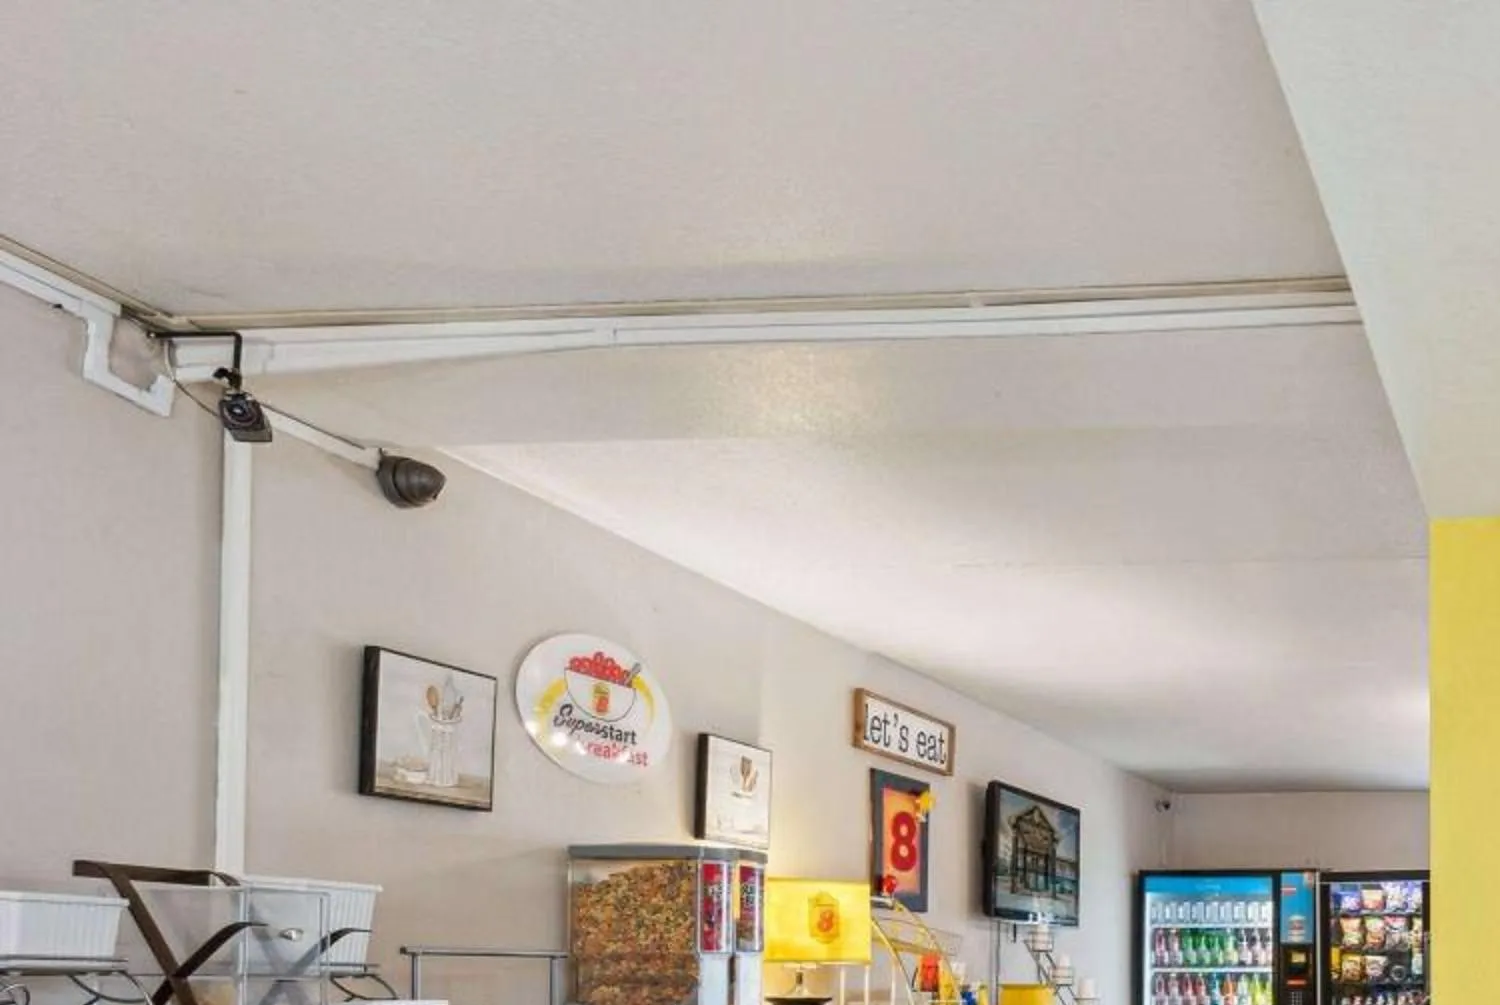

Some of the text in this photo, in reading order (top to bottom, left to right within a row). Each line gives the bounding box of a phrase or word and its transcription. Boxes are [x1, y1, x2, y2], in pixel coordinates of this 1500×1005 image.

[553, 703, 637, 745] Superstart
[864, 703, 947, 765] let's eat
[891, 811, 917, 871] 8
[816, 909, 834, 933] 8
